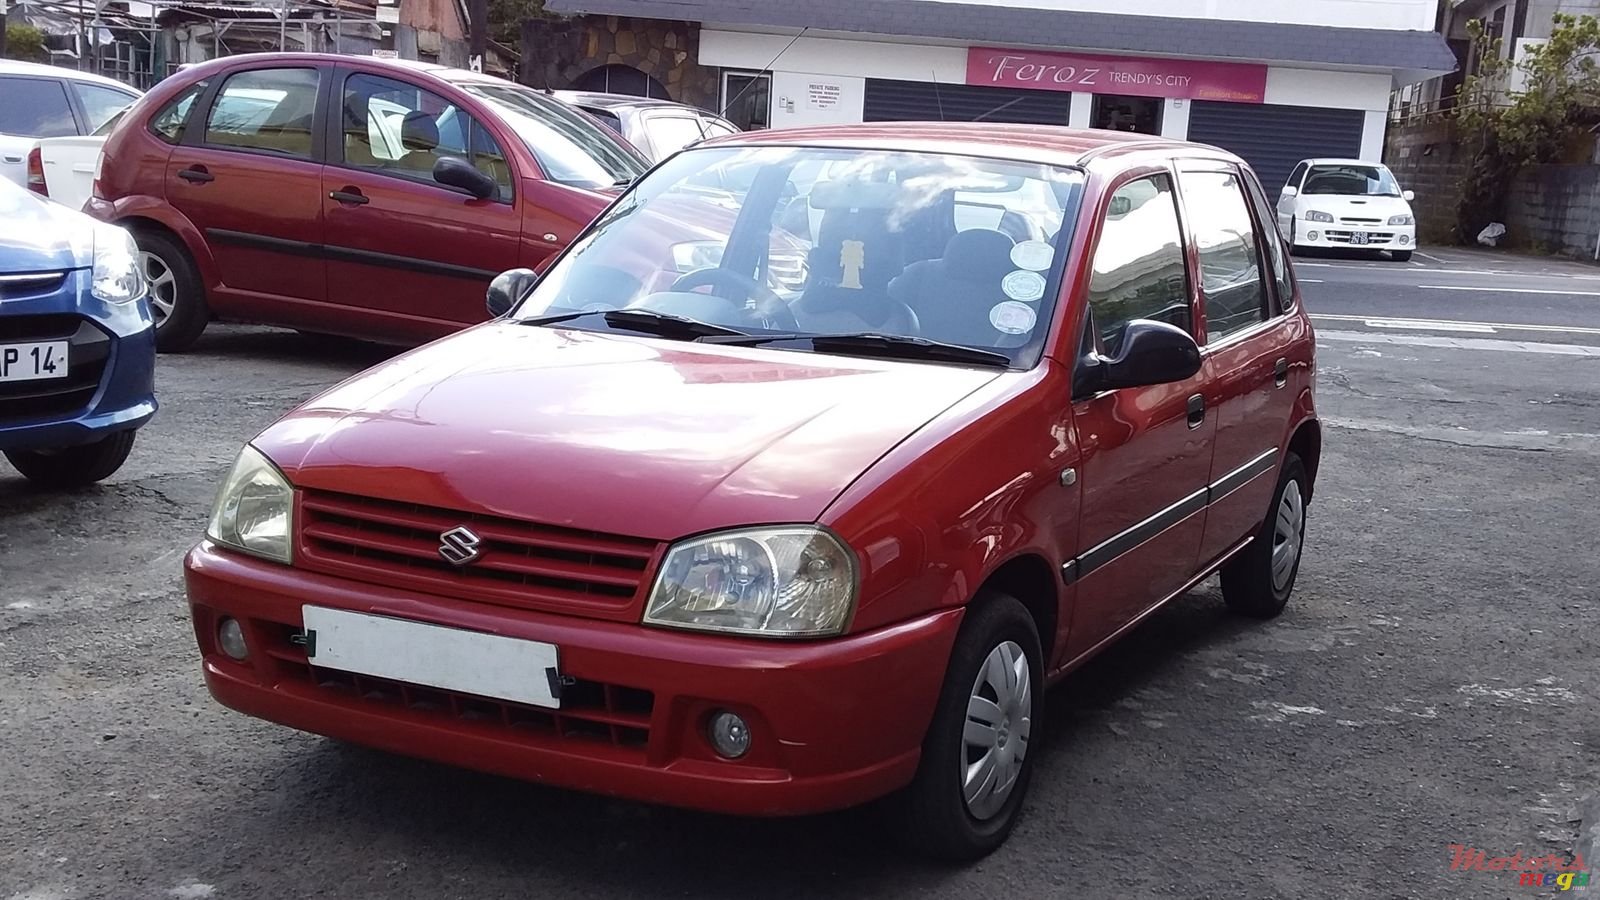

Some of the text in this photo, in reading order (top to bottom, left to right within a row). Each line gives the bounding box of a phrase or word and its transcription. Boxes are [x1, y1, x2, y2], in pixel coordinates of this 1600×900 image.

[988, 55, 1100, 85] Feroz
[1109, 72, 1191, 87] TRENDY'S CITY
[0, 346, 57, 377] P 14
